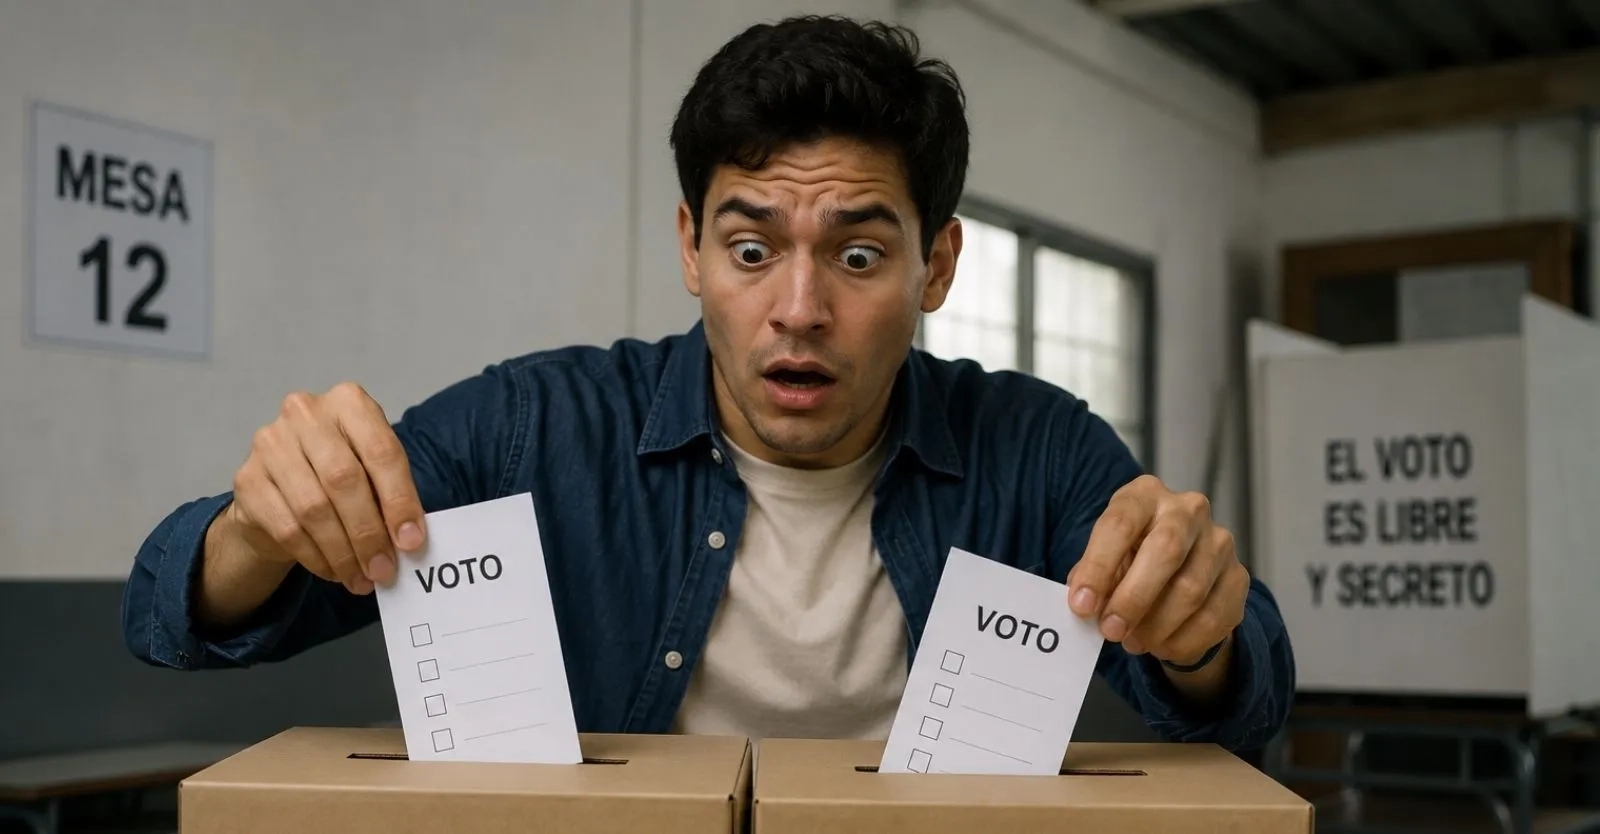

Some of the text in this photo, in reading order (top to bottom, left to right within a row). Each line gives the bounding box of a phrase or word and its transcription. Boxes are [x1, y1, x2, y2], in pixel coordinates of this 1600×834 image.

[56, 145, 190, 223] MESA
[79, 237, 169, 332] 12
[1325, 433, 1473, 484] EL VOTO
[1325, 496, 1478, 546] ES LIBRE
[414, 554, 504, 594] VOTO
[1305, 561, 1496, 609] Y SECRETO
[977, 605, 1060, 654] VOTO
